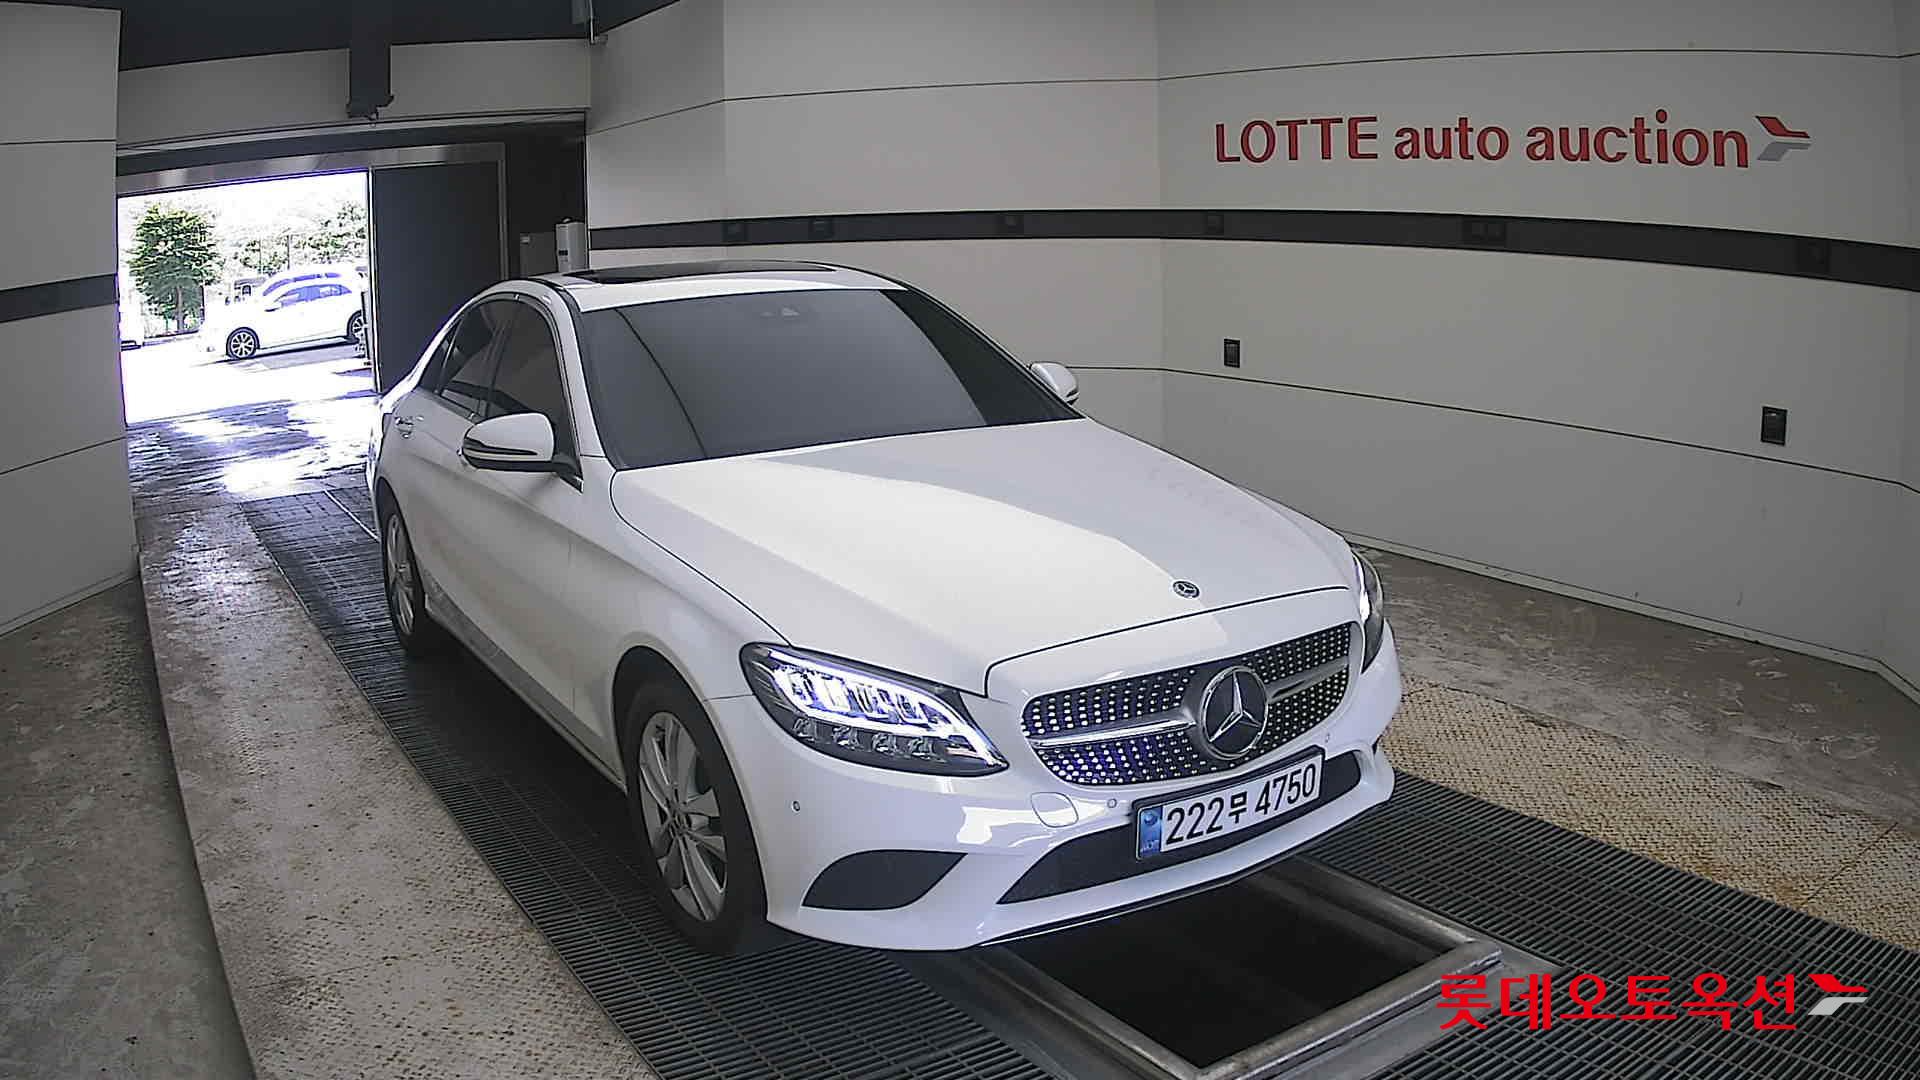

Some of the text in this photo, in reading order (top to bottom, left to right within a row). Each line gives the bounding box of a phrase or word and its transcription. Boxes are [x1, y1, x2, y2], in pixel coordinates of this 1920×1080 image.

[1215, 109, 1750, 168] LOTTE auto auction
[1255, 763, 1316, 815] 4750
